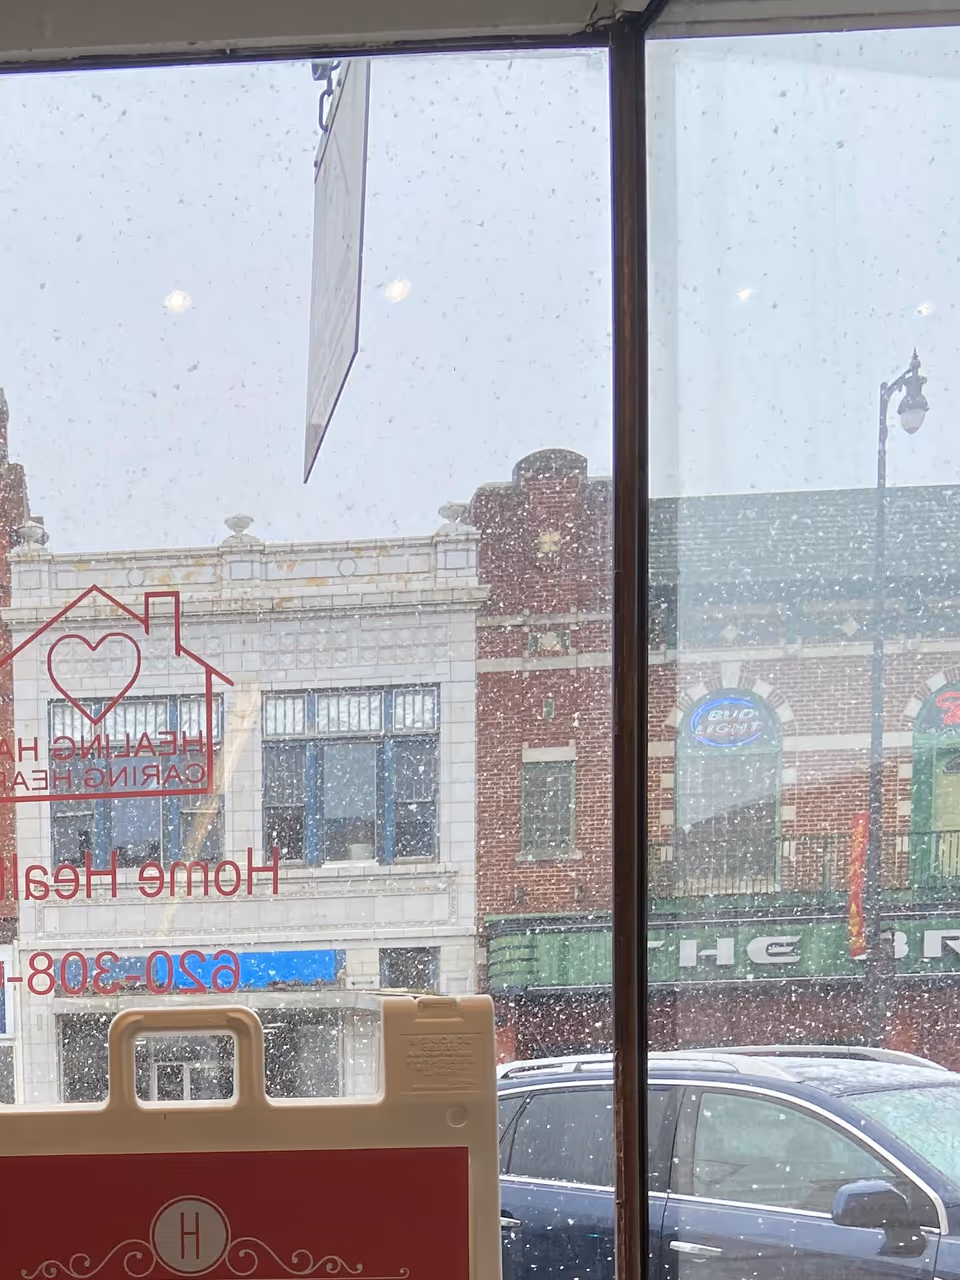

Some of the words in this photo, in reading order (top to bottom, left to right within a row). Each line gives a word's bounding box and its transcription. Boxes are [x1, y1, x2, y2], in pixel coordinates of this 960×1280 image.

[707, 708, 754, 720] BUD
[695, 720, 762, 734] LIGHT
[647, 935, 802, 967] HE
[179, 1211, 200, 1260] H
